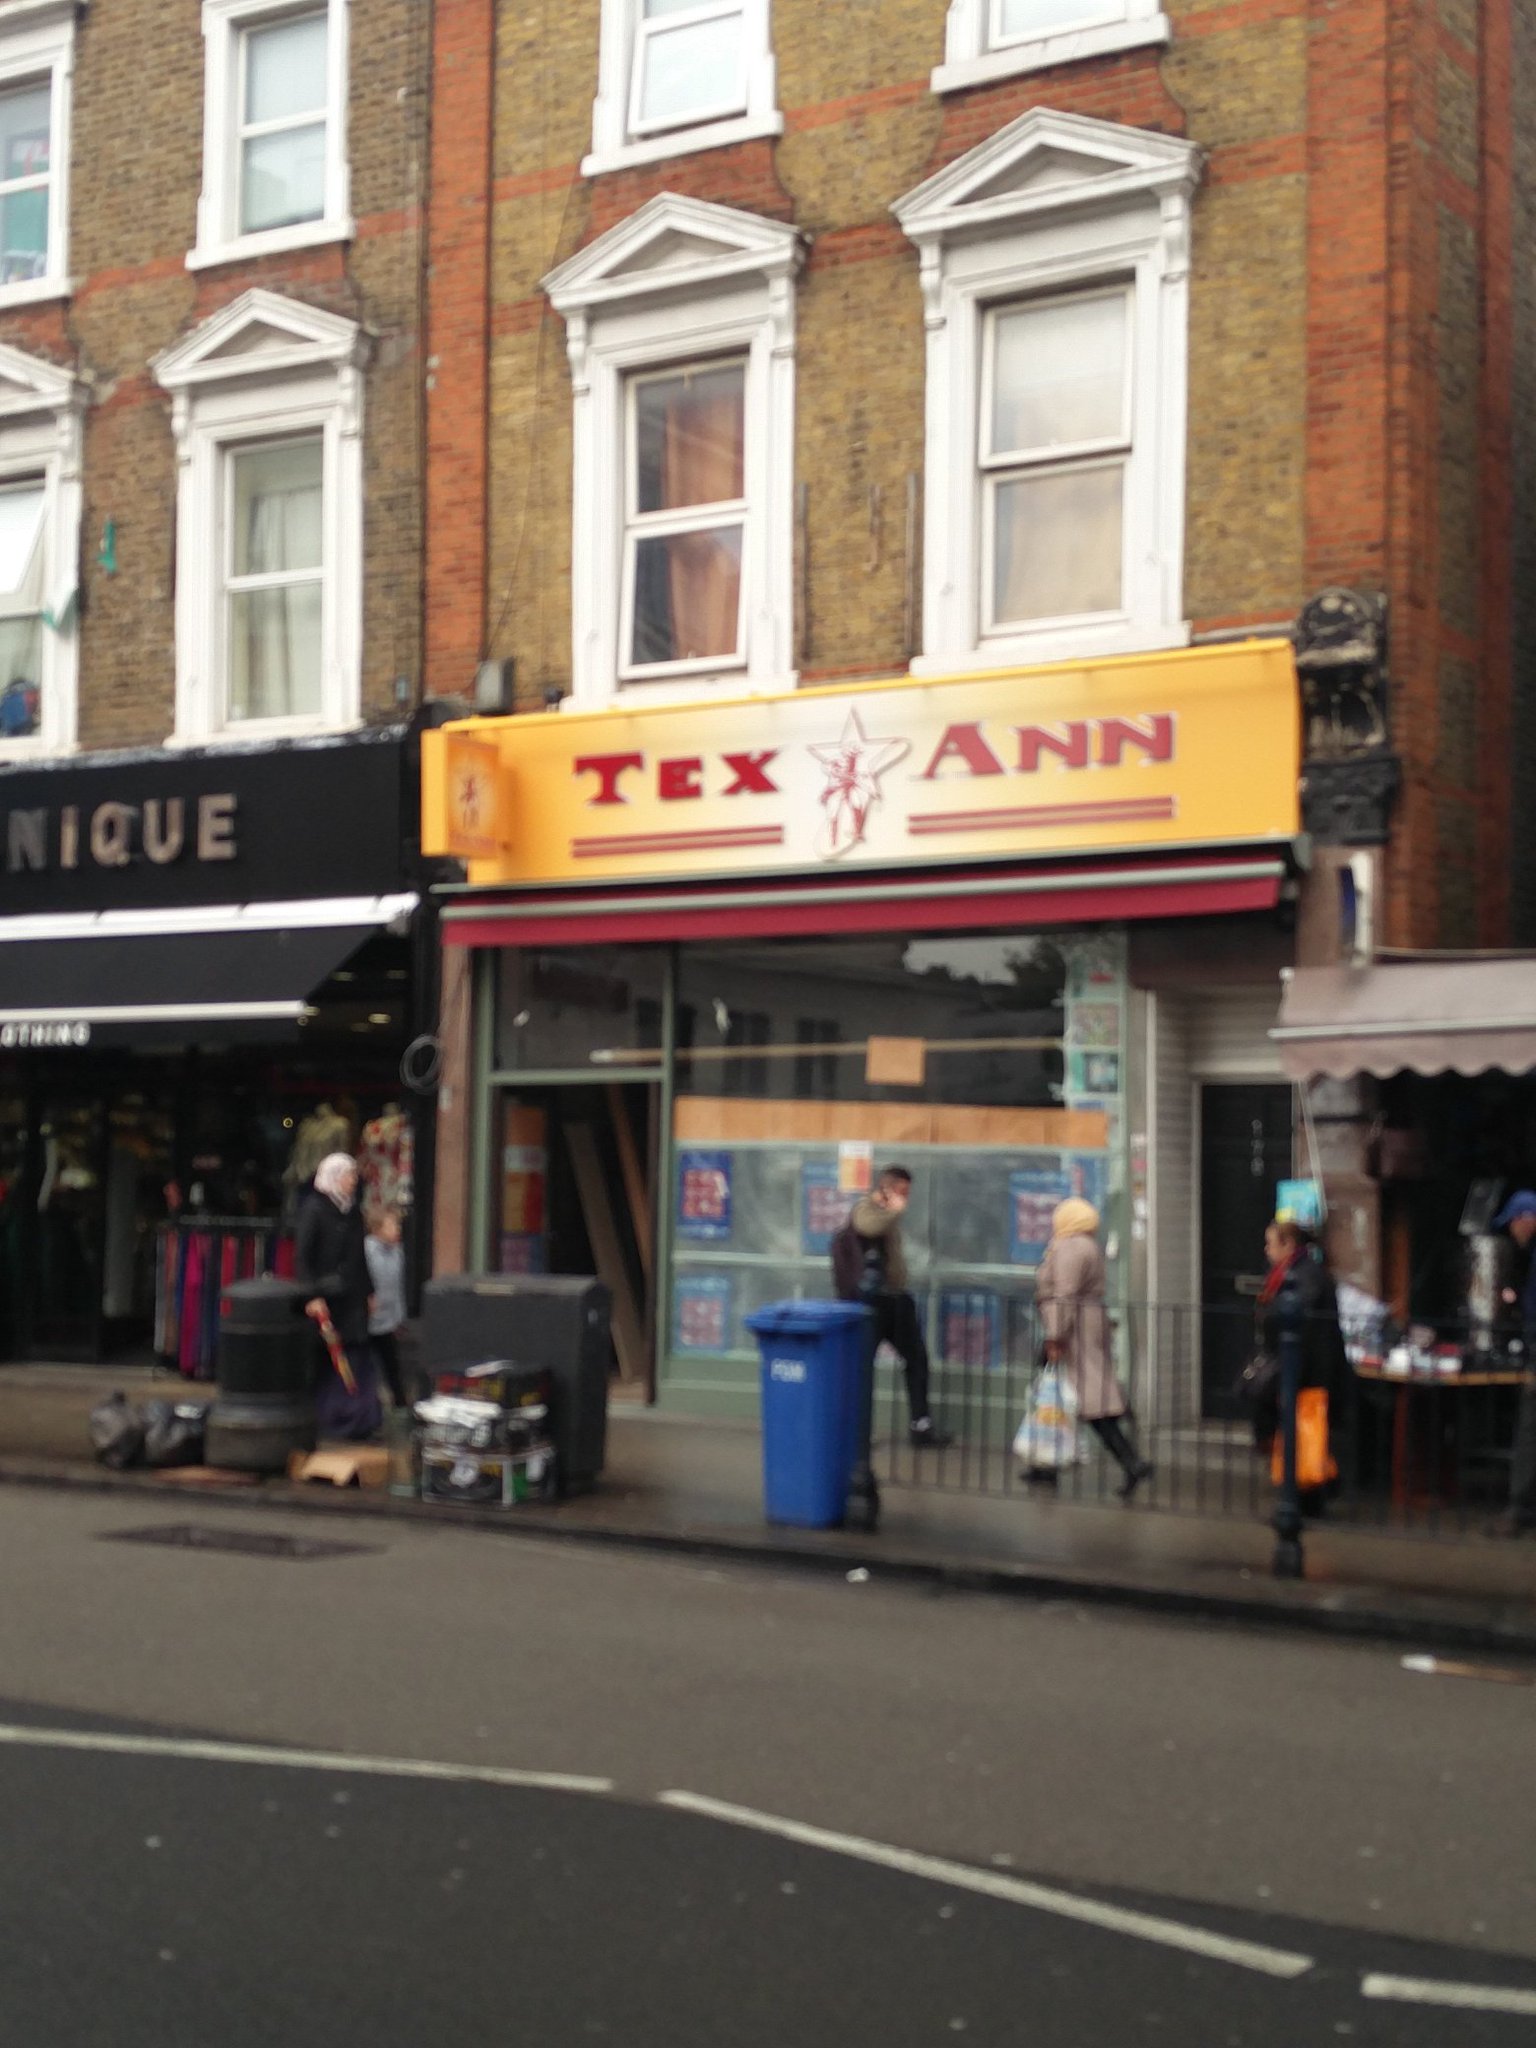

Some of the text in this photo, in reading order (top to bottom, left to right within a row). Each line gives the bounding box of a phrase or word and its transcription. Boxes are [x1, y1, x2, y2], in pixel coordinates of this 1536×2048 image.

[572, 713, 1175, 806] TEX ANN
[6, 793, 238, 872] NIQUE
